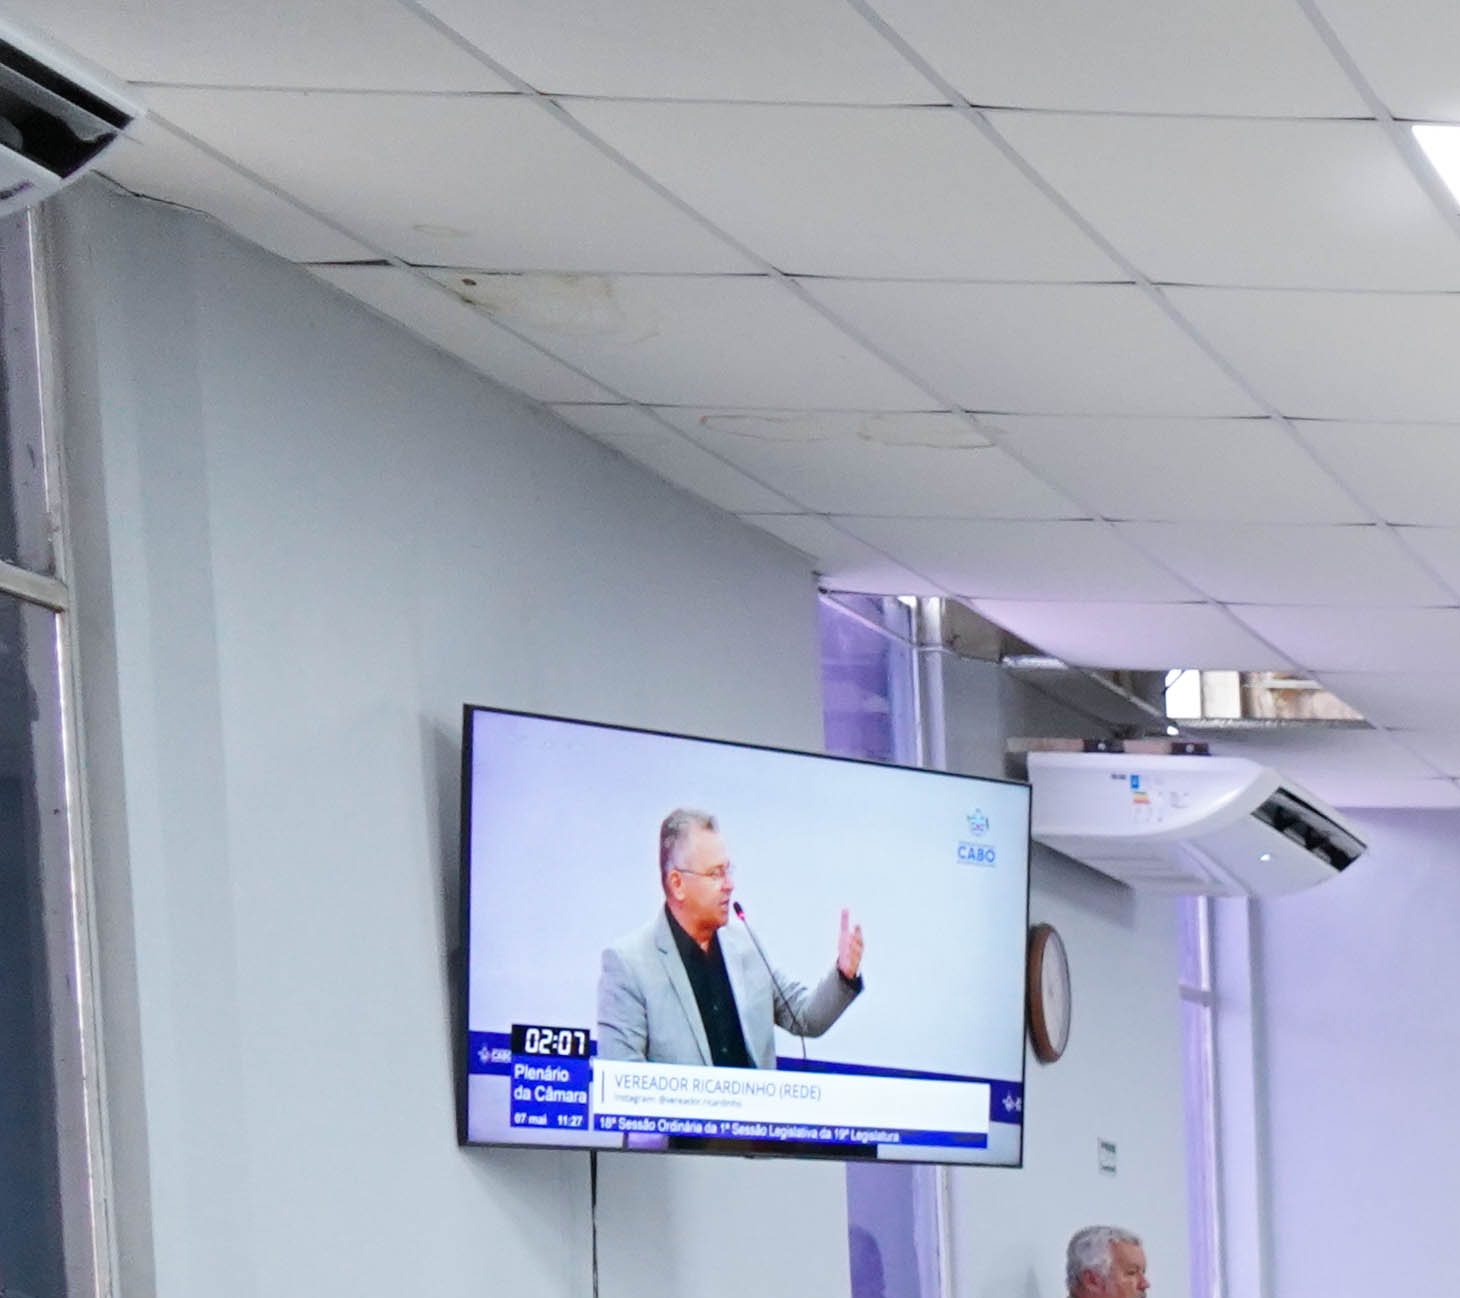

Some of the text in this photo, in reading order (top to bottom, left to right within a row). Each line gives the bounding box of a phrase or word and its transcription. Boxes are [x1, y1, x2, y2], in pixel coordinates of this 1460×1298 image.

[958, 846, 995, 863] CABO
[525, 1028, 585, 1055] 02:07
[514, 1063, 569, 1082] Plenário
[514, 1084, 587, 1104] da Câmara
[614, 1073, 822, 1101] VEREADOR RICARDINHO (REDE)
